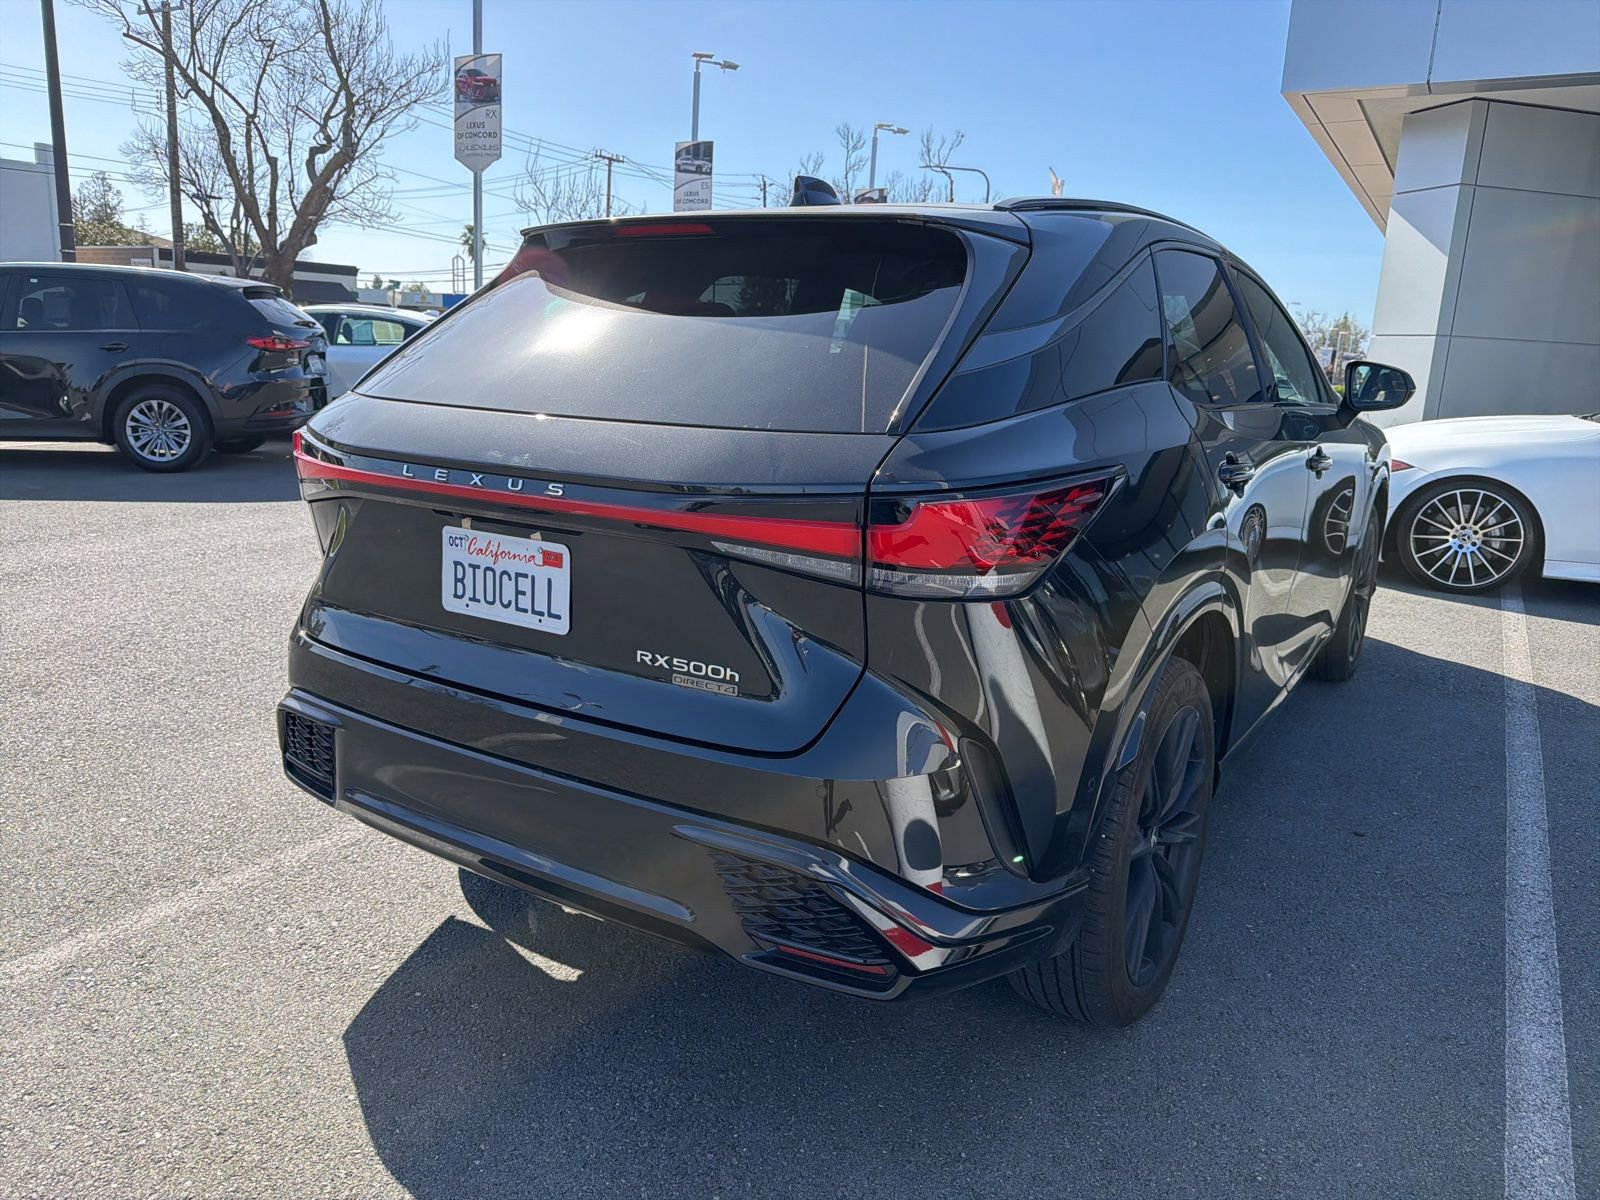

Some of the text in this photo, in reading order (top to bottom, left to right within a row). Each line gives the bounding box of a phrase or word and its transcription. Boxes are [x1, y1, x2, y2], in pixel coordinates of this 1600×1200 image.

[466, 121, 486, 129] LEXUS
[485, 109, 497, 118] RX
[456, 131, 498, 140] OF CONCORD
[402, 464, 565, 497] LEXUS
[448, 535, 544, 566] OCT California
[452, 560, 562, 621] BIOCELL
[636, 650, 740, 682] RX500h
